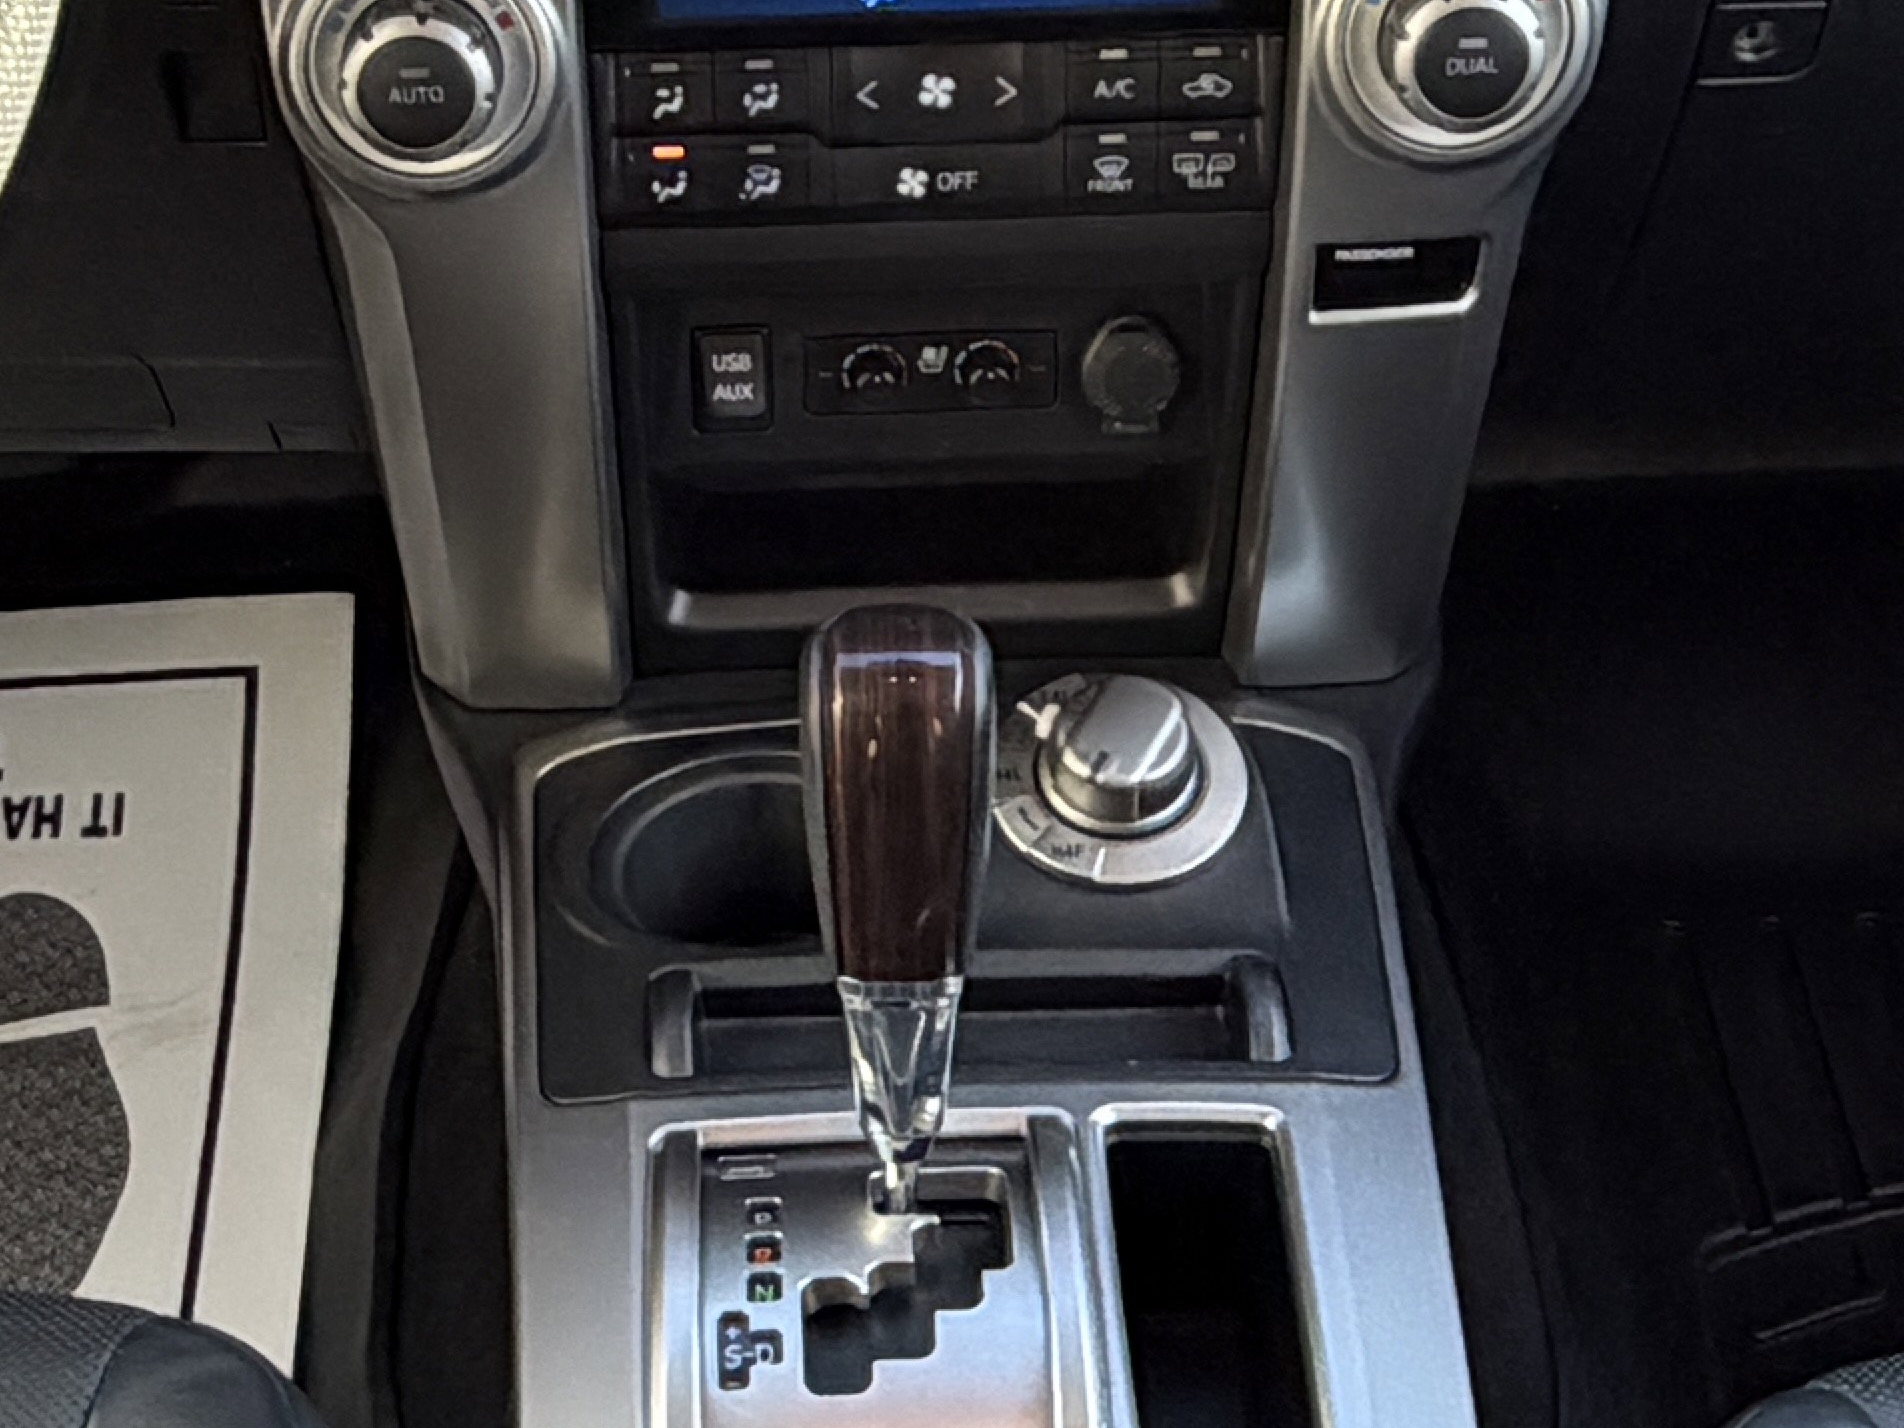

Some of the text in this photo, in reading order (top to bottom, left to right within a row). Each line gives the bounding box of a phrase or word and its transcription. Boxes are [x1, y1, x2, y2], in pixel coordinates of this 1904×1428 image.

[1446, 56, 1498, 76] DUAL
[388, 85, 445, 105] AUTO
[1093, 77, 1136, 99] A/C
[937, 171, 978, 191] OFF
[712, 352, 753, 372] USB
[712, 383, 755, 402] AUX
[81, 791, 126, 838] IT
[754, 1282, 774, 1303] N
